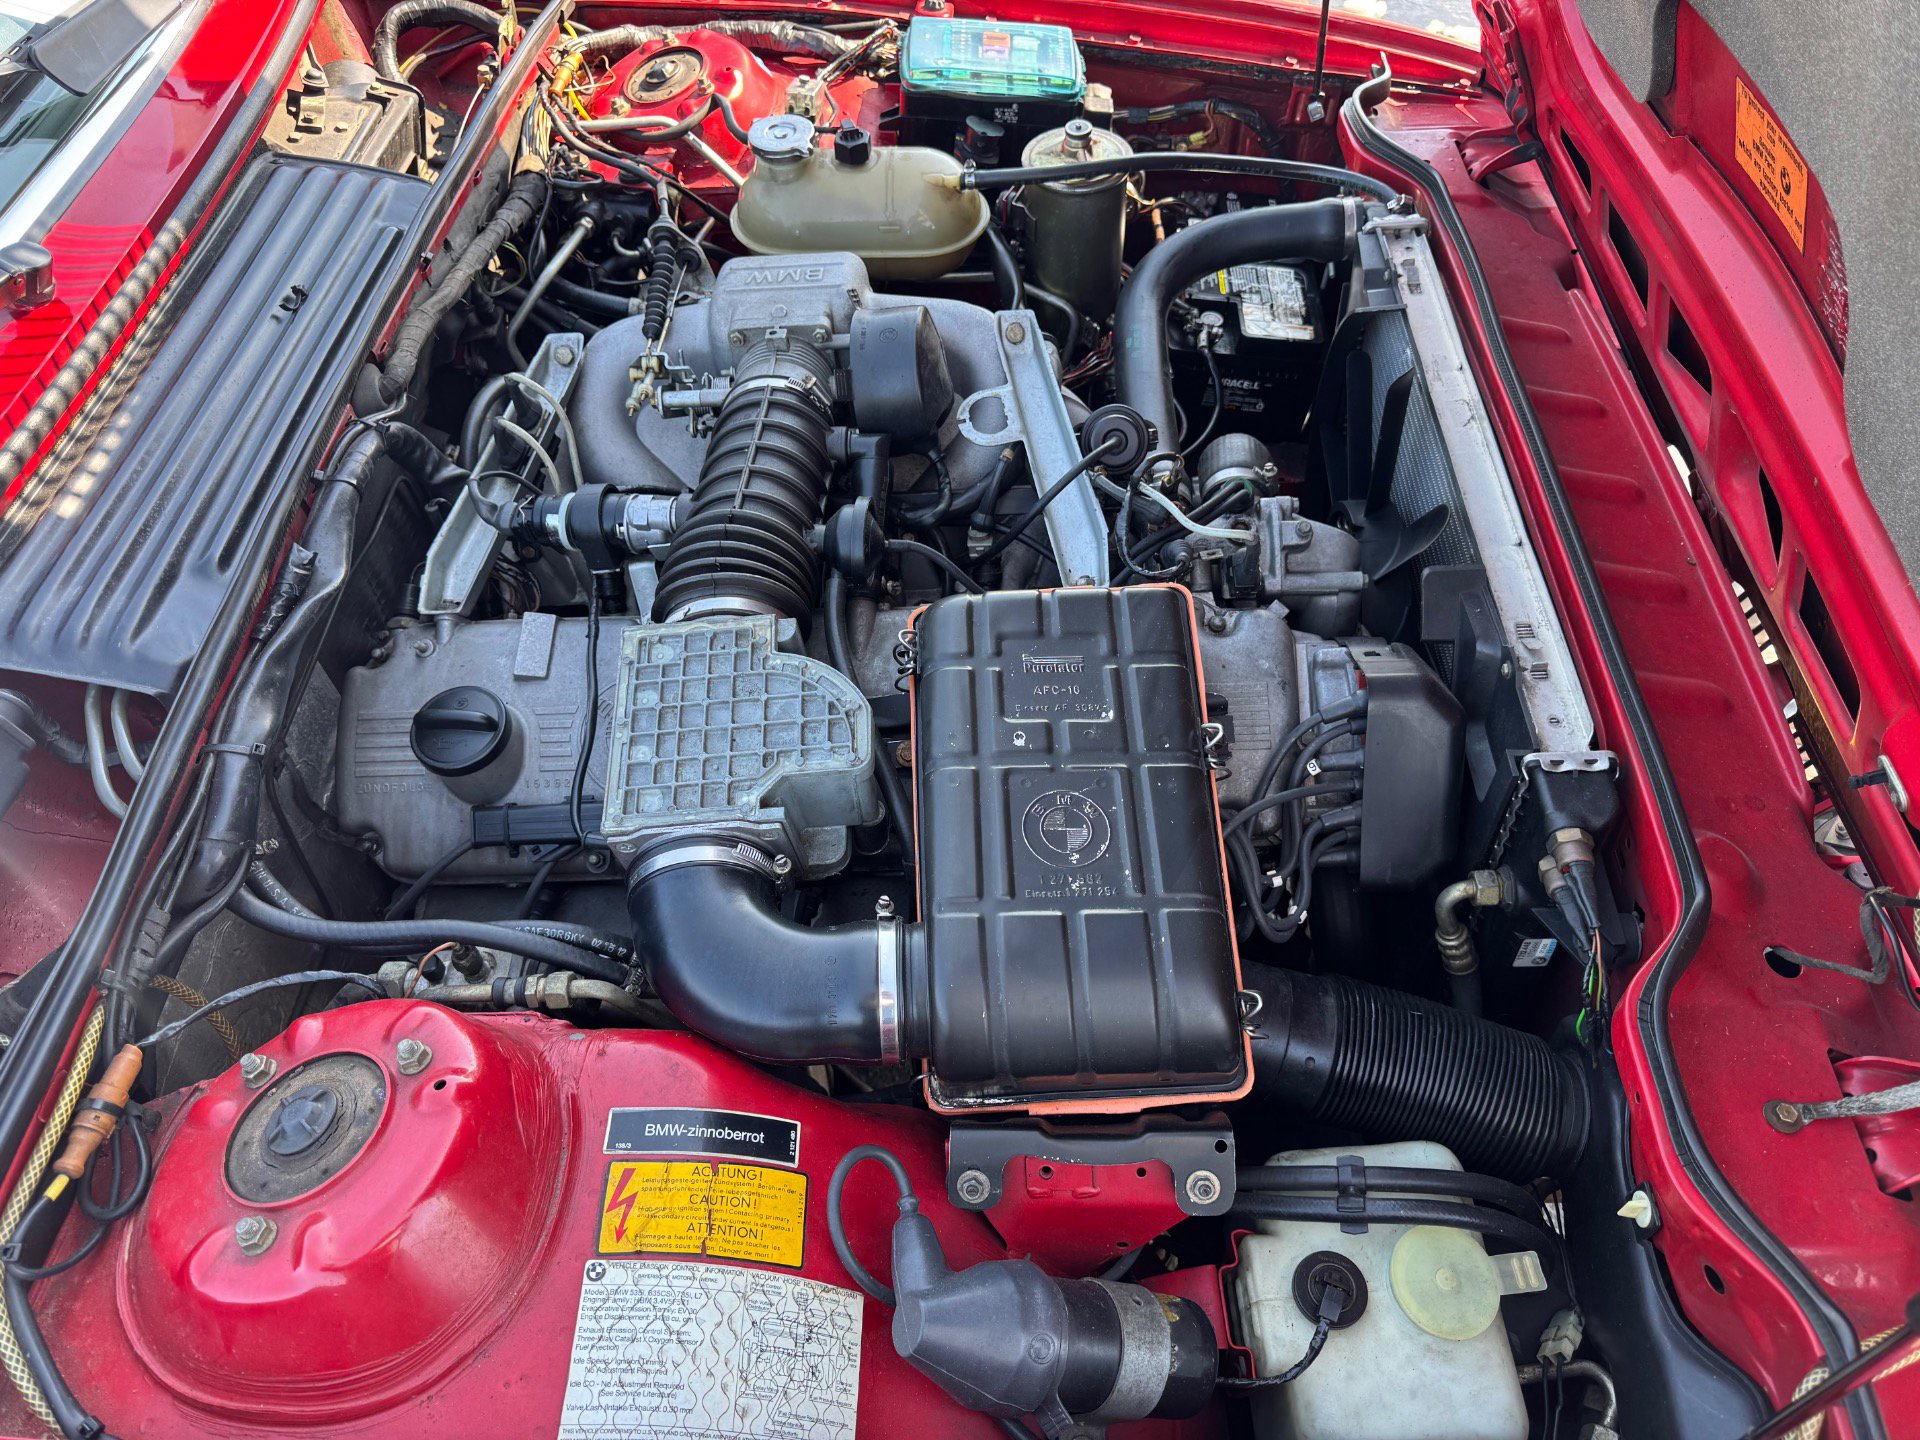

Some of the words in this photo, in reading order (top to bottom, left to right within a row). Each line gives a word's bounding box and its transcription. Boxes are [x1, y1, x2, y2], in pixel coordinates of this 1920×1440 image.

[1738, 138, 1752, 160] which
[1753, 139, 1763, 159] BMW
[745, 267, 825, 284] BMW
[1022, 662, 1085, 673] Purolator
[644, 1123, 765, 1144] BMW-zinnoberrot
[677, 1205, 702, 1213] ignition
[672, 1264, 701, 1272] CONTROL
[609, 1289, 628, 1297] BMW
